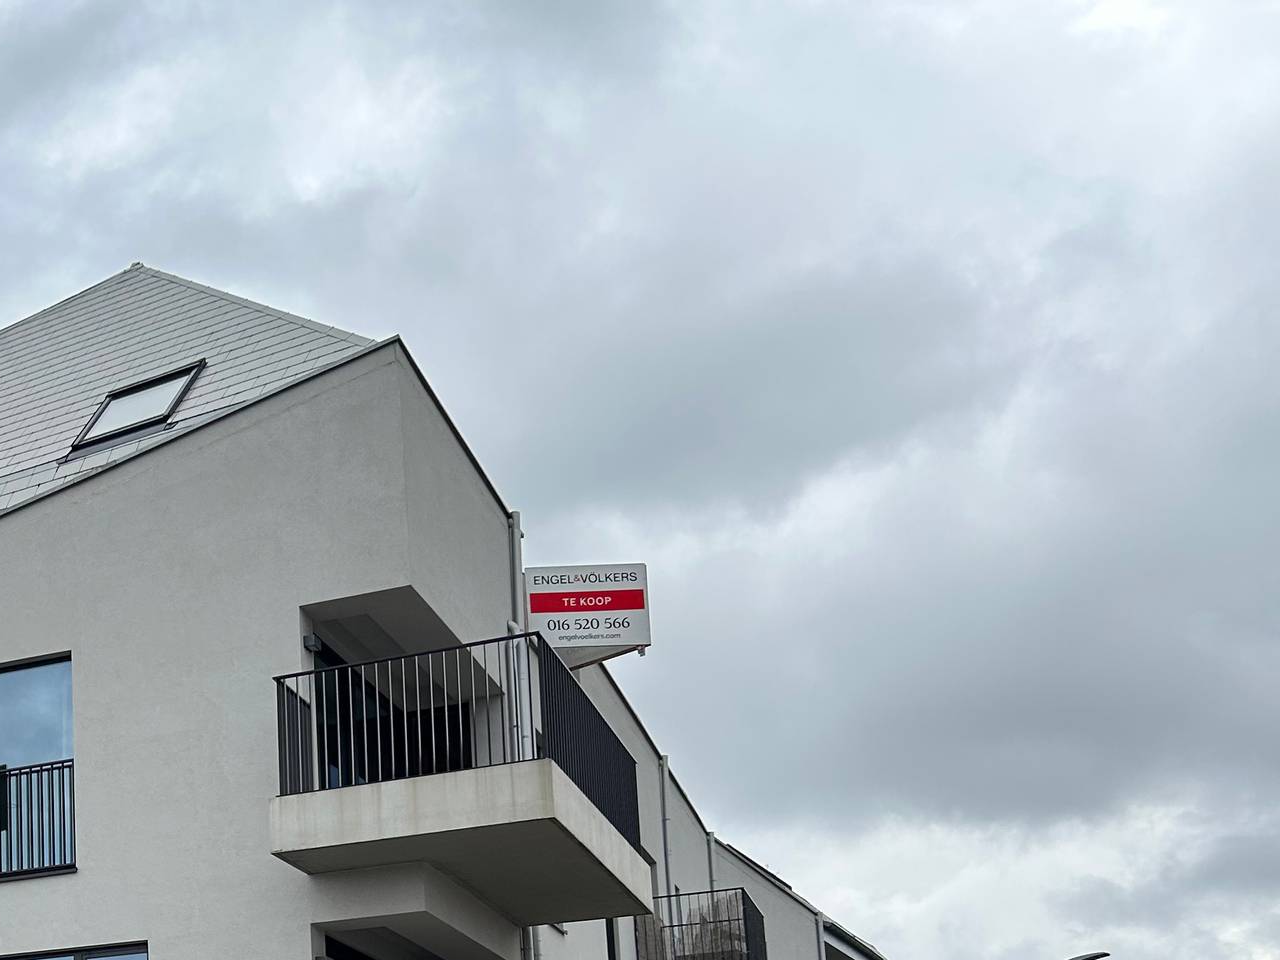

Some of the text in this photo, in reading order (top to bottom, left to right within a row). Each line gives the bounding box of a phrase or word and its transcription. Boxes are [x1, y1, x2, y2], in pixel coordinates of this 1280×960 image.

[562, 596, 612, 607] TE KOOP
[547, 617, 630, 631] 016 520 566
[558, 633, 622, 642] engelvoelkers.com
